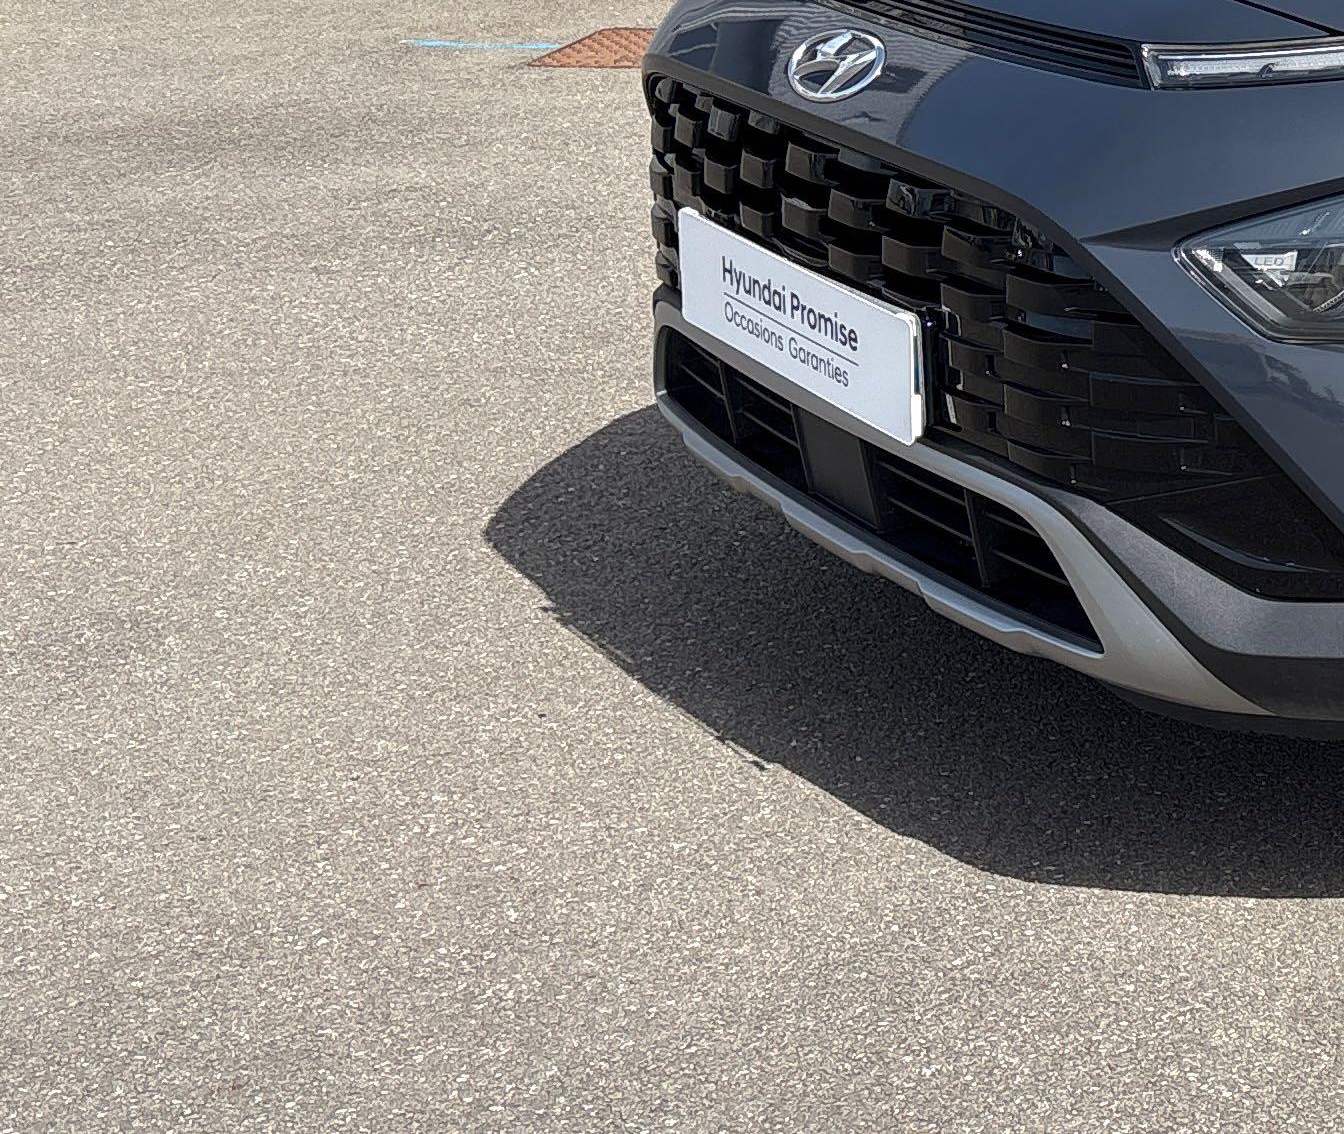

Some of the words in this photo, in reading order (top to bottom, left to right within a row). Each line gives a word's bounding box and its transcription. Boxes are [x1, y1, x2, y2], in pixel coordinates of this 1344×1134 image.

[722, 256, 786, 315] Hyundai
[790, 292, 858, 351] Promise
[1254, 257, 1284, 266] LED
[724, 301, 784, 351] Occasions
[788, 337, 849, 387] Garanties
